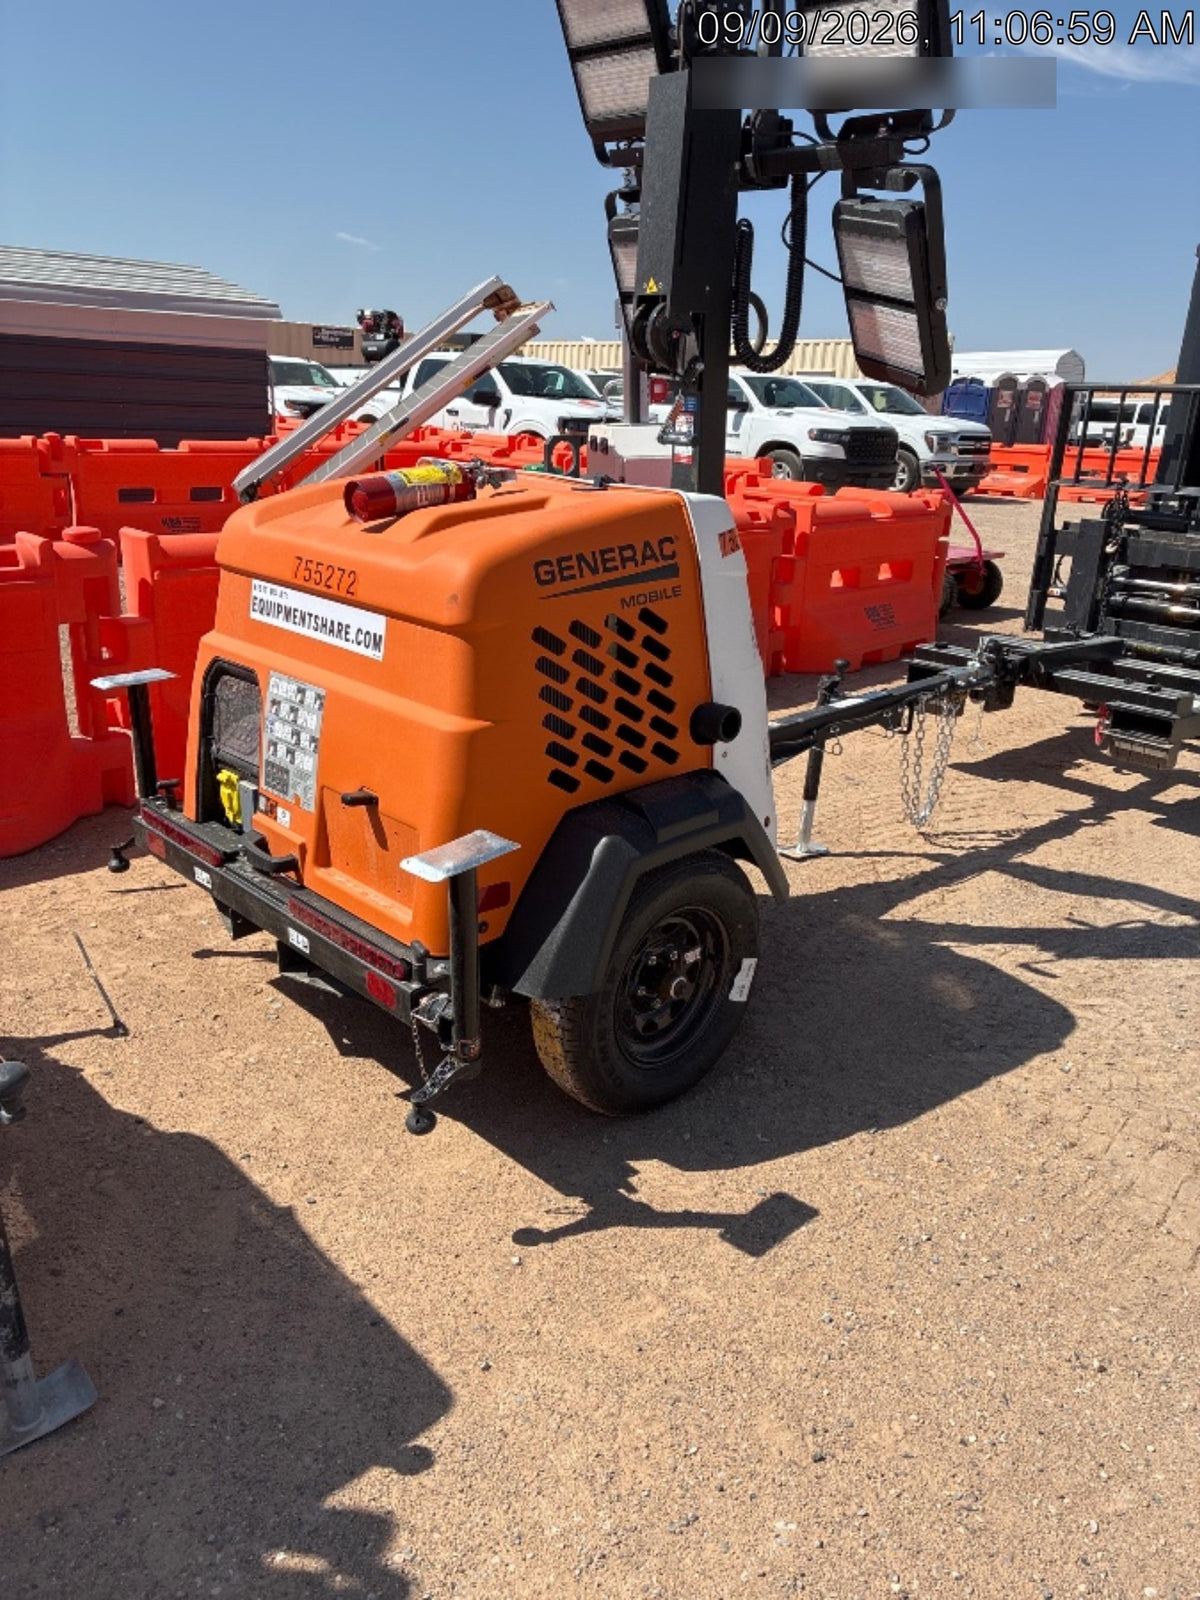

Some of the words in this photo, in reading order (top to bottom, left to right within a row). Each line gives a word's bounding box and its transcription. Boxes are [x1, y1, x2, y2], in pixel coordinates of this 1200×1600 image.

[293, 556, 358, 597] 755272
[533, 536, 677, 586] GENERAC
[620, 585, 682, 609] MOBILE
[252, 595, 383, 653] EQUIPMENTSHARE.COM
